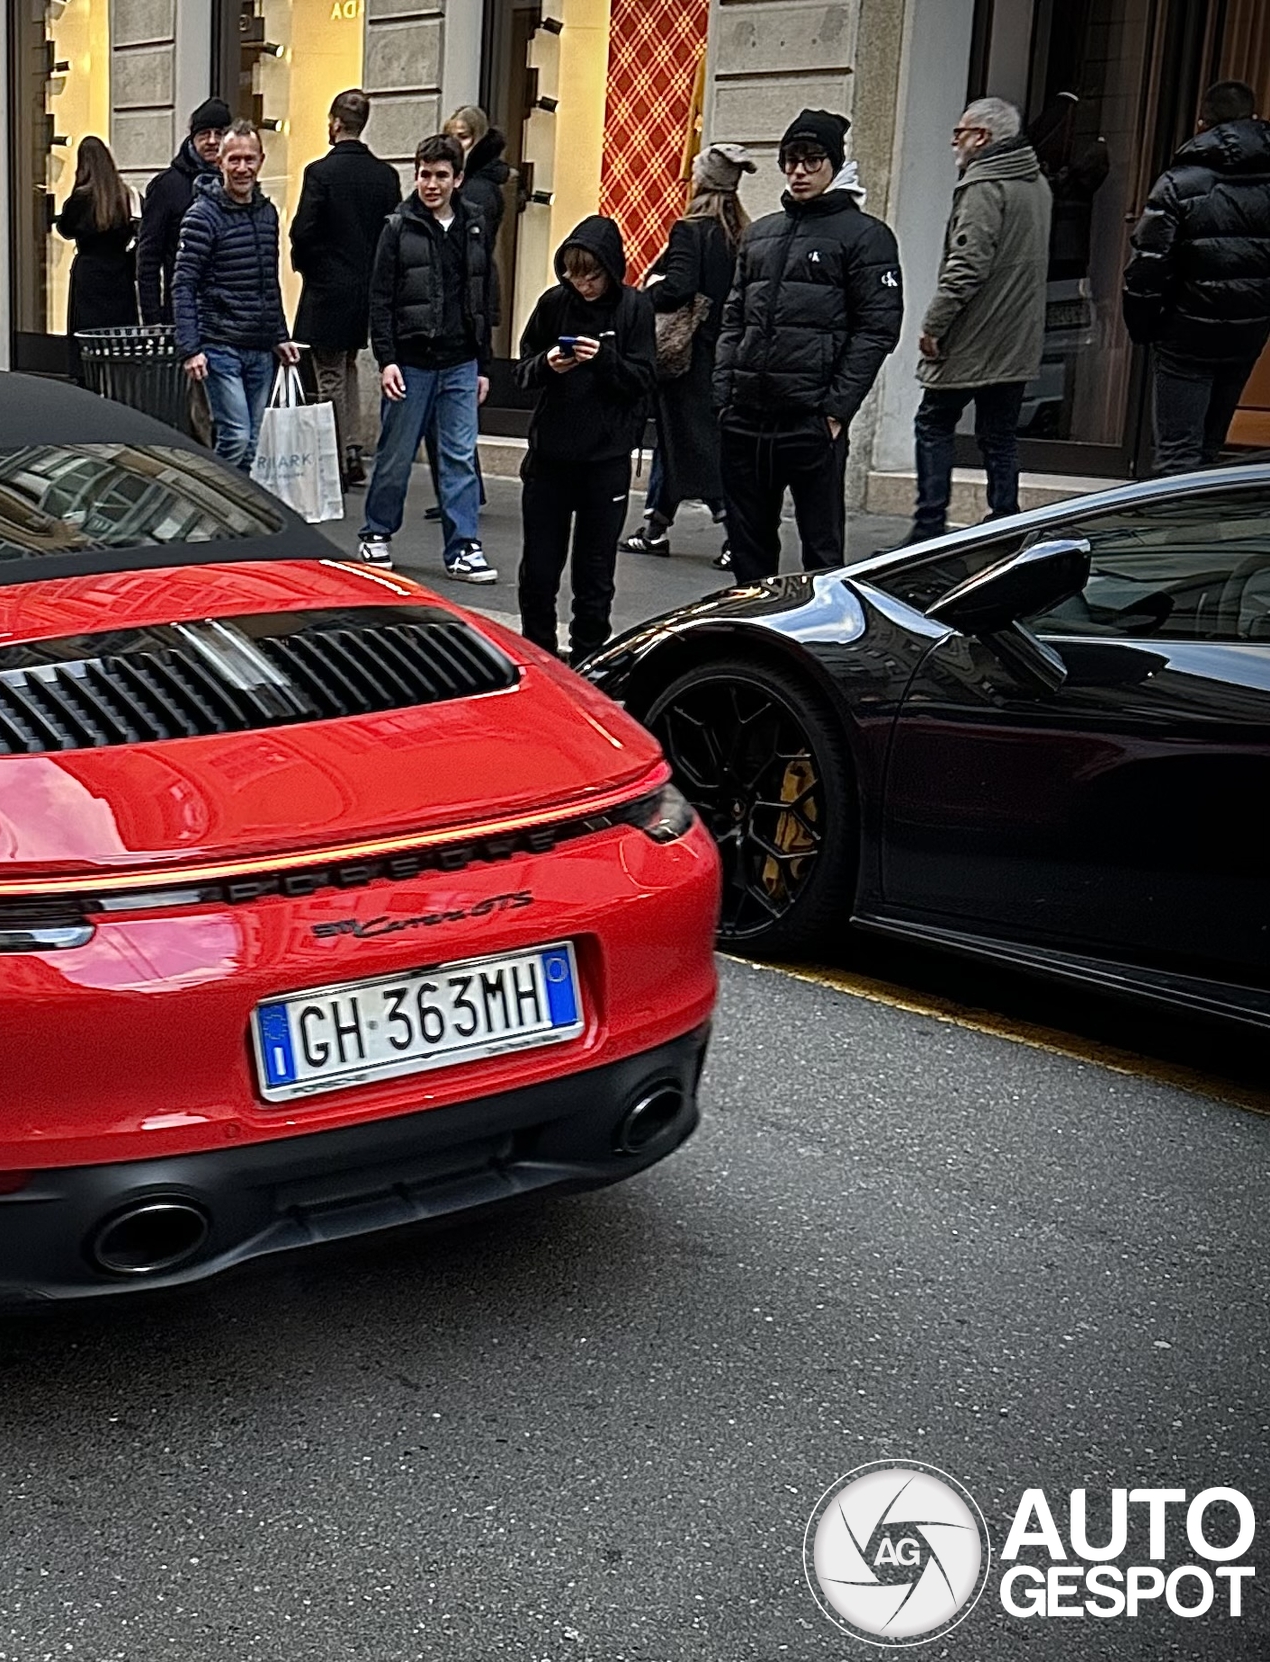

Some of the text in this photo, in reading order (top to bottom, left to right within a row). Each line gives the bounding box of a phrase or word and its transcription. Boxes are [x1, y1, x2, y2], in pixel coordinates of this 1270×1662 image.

[470, 890, 534, 916] GTS
[299, 963, 542, 1067] GH 363MH
